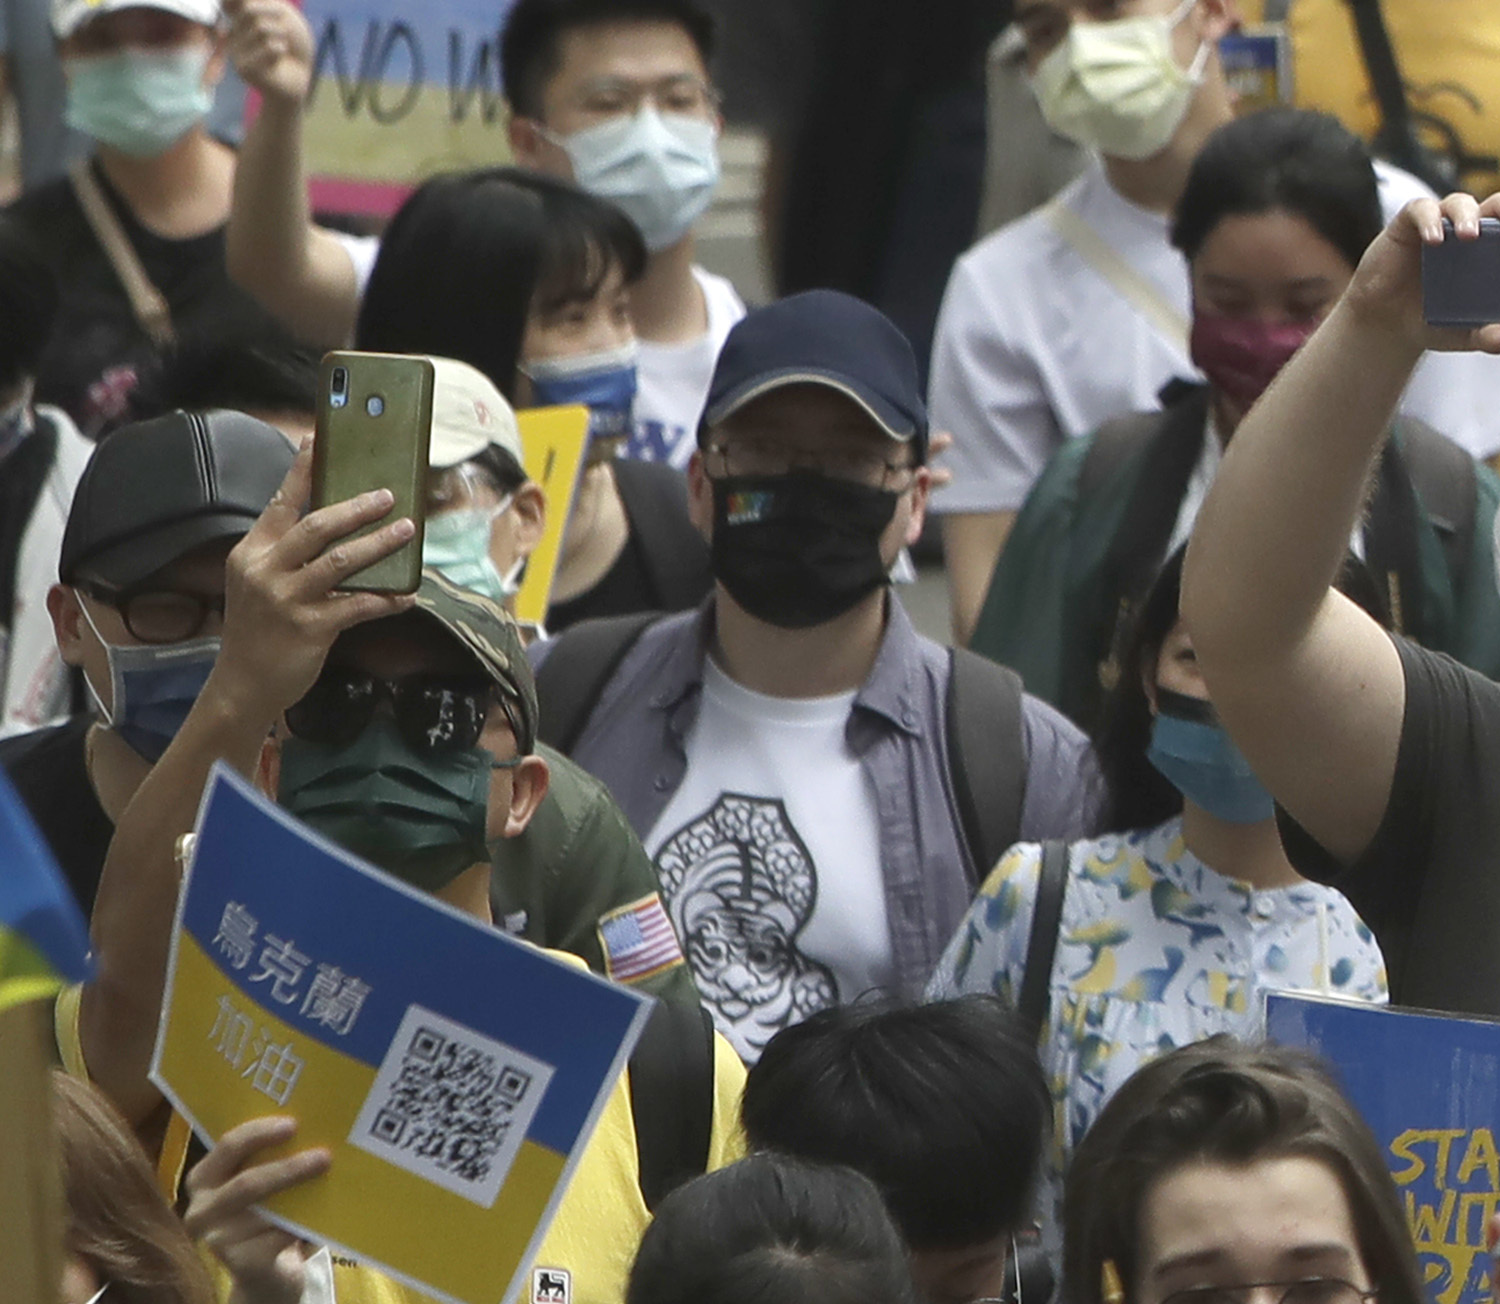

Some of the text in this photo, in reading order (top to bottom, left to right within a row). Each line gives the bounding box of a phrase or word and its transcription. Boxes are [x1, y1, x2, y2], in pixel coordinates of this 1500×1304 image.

[303, 16, 425, 124] NO
[211, 900, 374, 1036] 烏克蘭
[207, 994, 306, 1108] 加油
